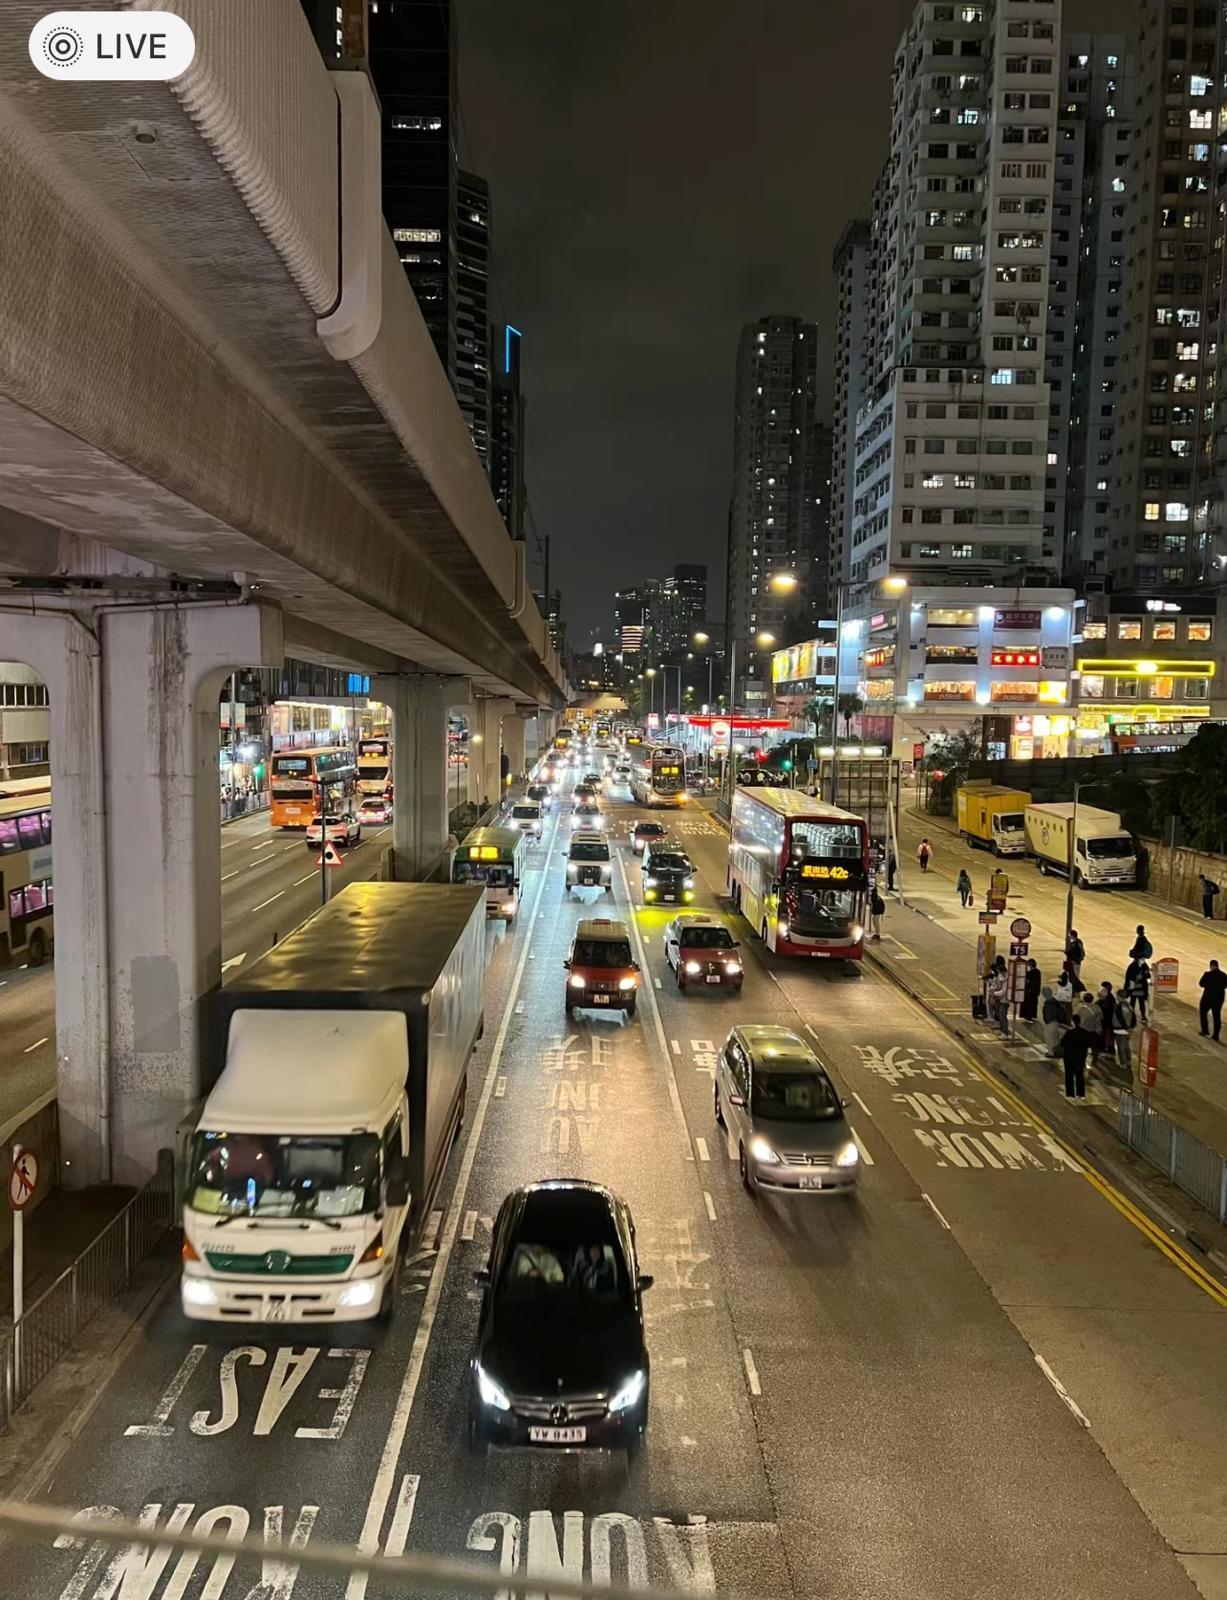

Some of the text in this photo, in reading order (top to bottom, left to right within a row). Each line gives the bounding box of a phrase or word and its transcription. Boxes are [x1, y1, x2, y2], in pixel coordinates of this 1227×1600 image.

[891, 1091, 1033, 1127] TONG
[912, 1128, 1086, 1173] KWUN
[123, 1344, 373, 1440] EAST
